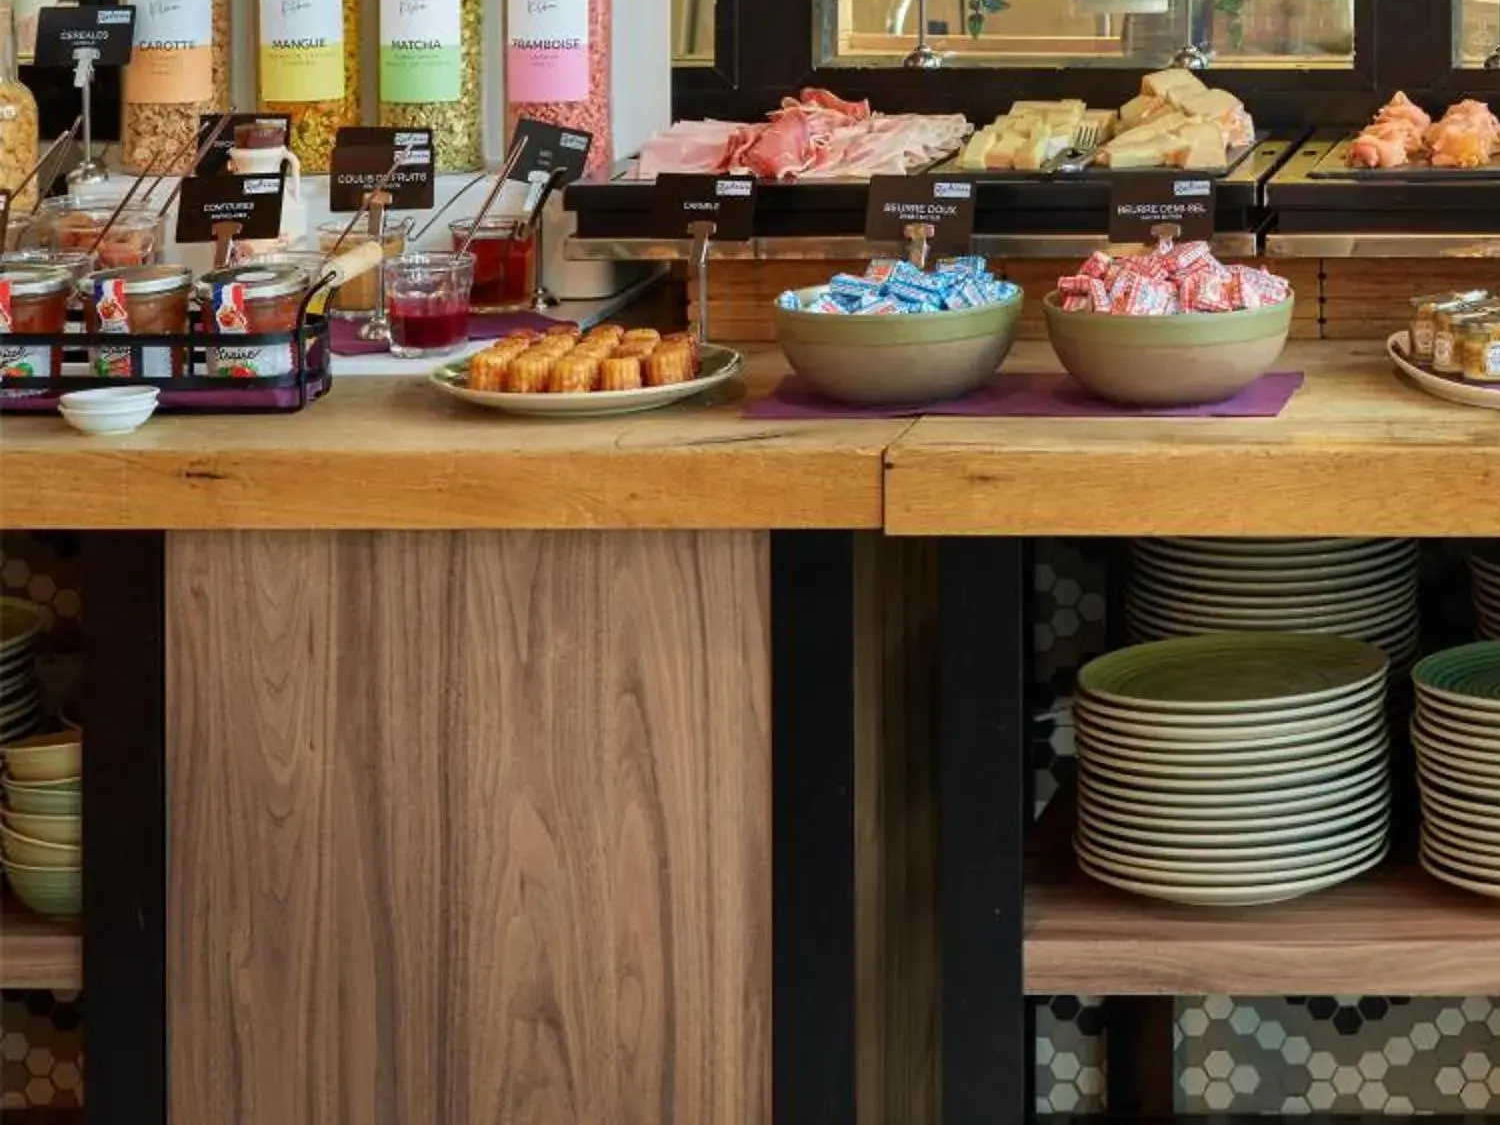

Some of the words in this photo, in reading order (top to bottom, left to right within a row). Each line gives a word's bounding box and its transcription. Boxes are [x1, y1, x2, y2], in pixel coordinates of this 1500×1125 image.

[139, 39, 195, 52] CAROTTE
[272, 37, 327, 50] MANGUE
[391, 38, 443, 51] MATCHA
[512, 37, 581, 50] FRAMBOISE
